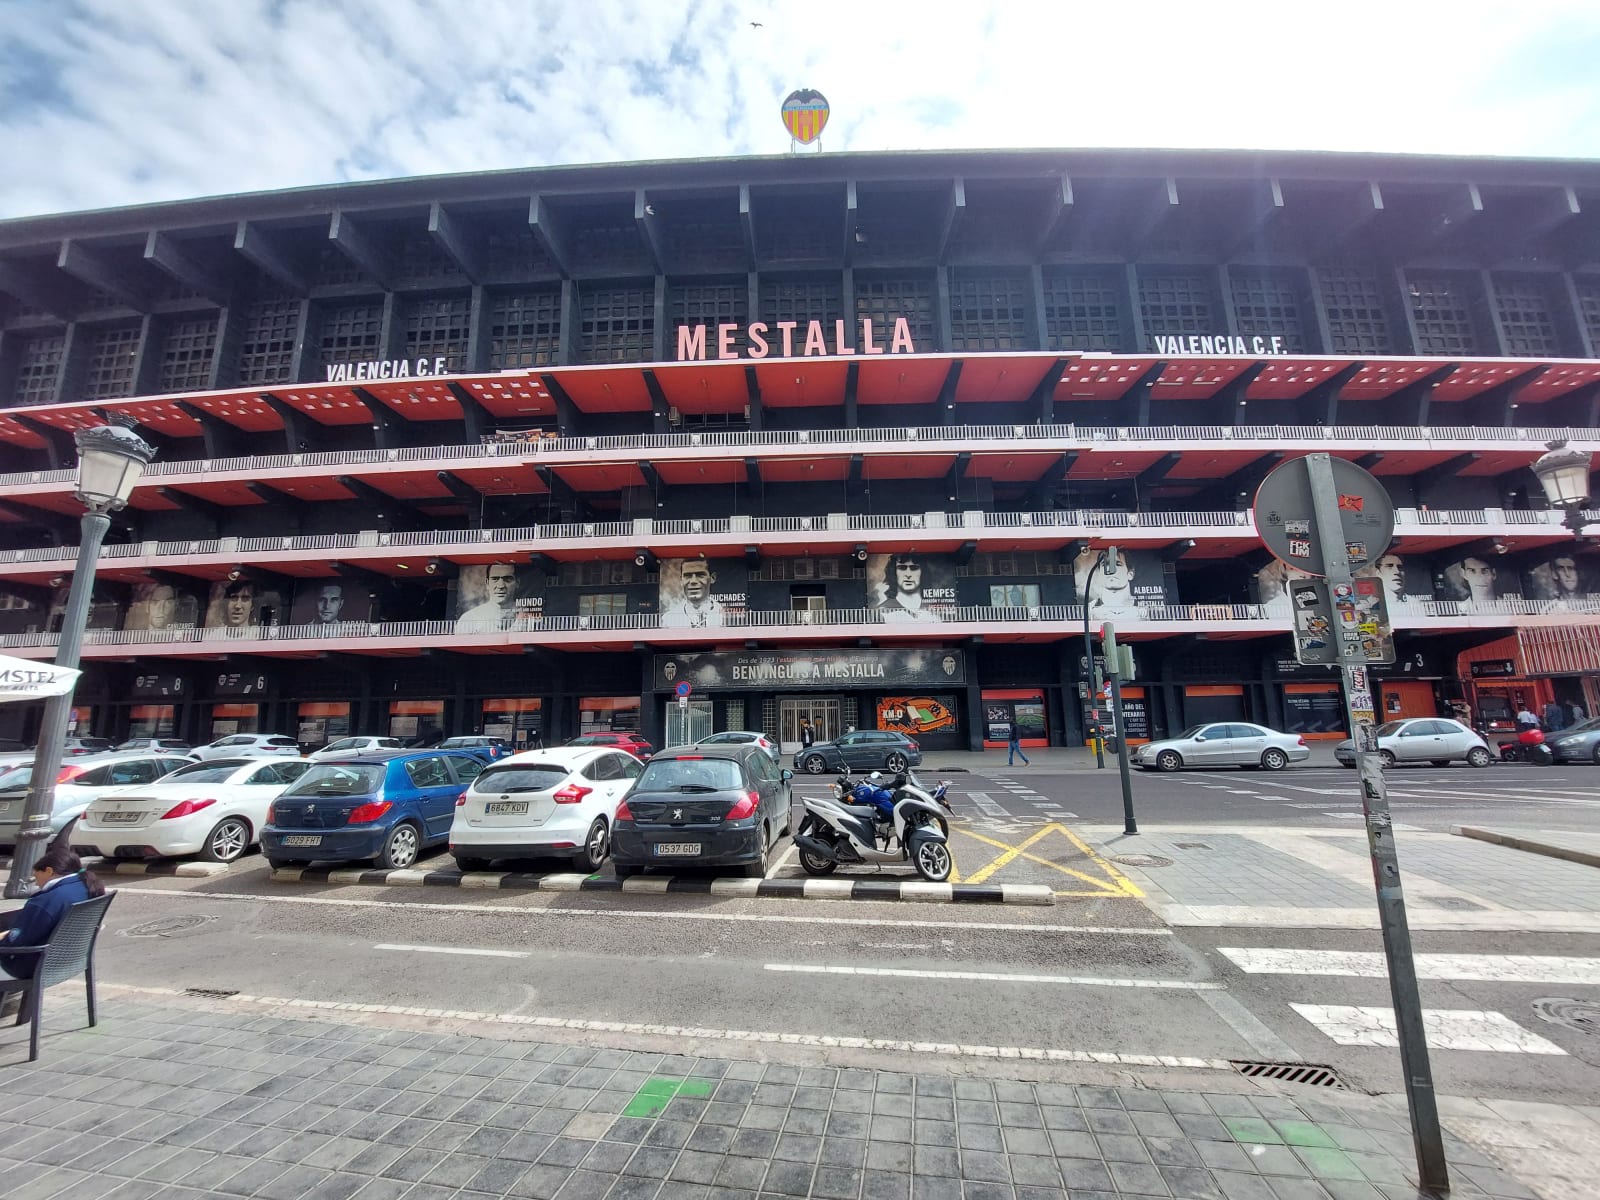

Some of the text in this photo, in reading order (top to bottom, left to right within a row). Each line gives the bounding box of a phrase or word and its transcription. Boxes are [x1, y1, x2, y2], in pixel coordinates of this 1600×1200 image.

[677, 317, 915, 360] MESTALLA
[1154, 335, 1288, 354] VALENCIA C.F.
[327, 357, 449, 381] VALENCIA C.F.
[1290, 540, 1310, 550] FCK
[922, 588, 955, 598] KEMPES
[1133, 586, 1163, 594] ALBELDA
[515, 597, 543, 607] MUNDO
[709, 593, 746, 601] PUCHADES
[1415, 653, 1424, 667] 3
[732, 663, 884, 680] BENVINGUTS A MESTALLA
[174, 677, 182, 691] 8
[257, 676, 264, 690] 6
[490, 803, 526, 812] 6847 KDV
[659, 844, 700, 853] 0537 GDG
